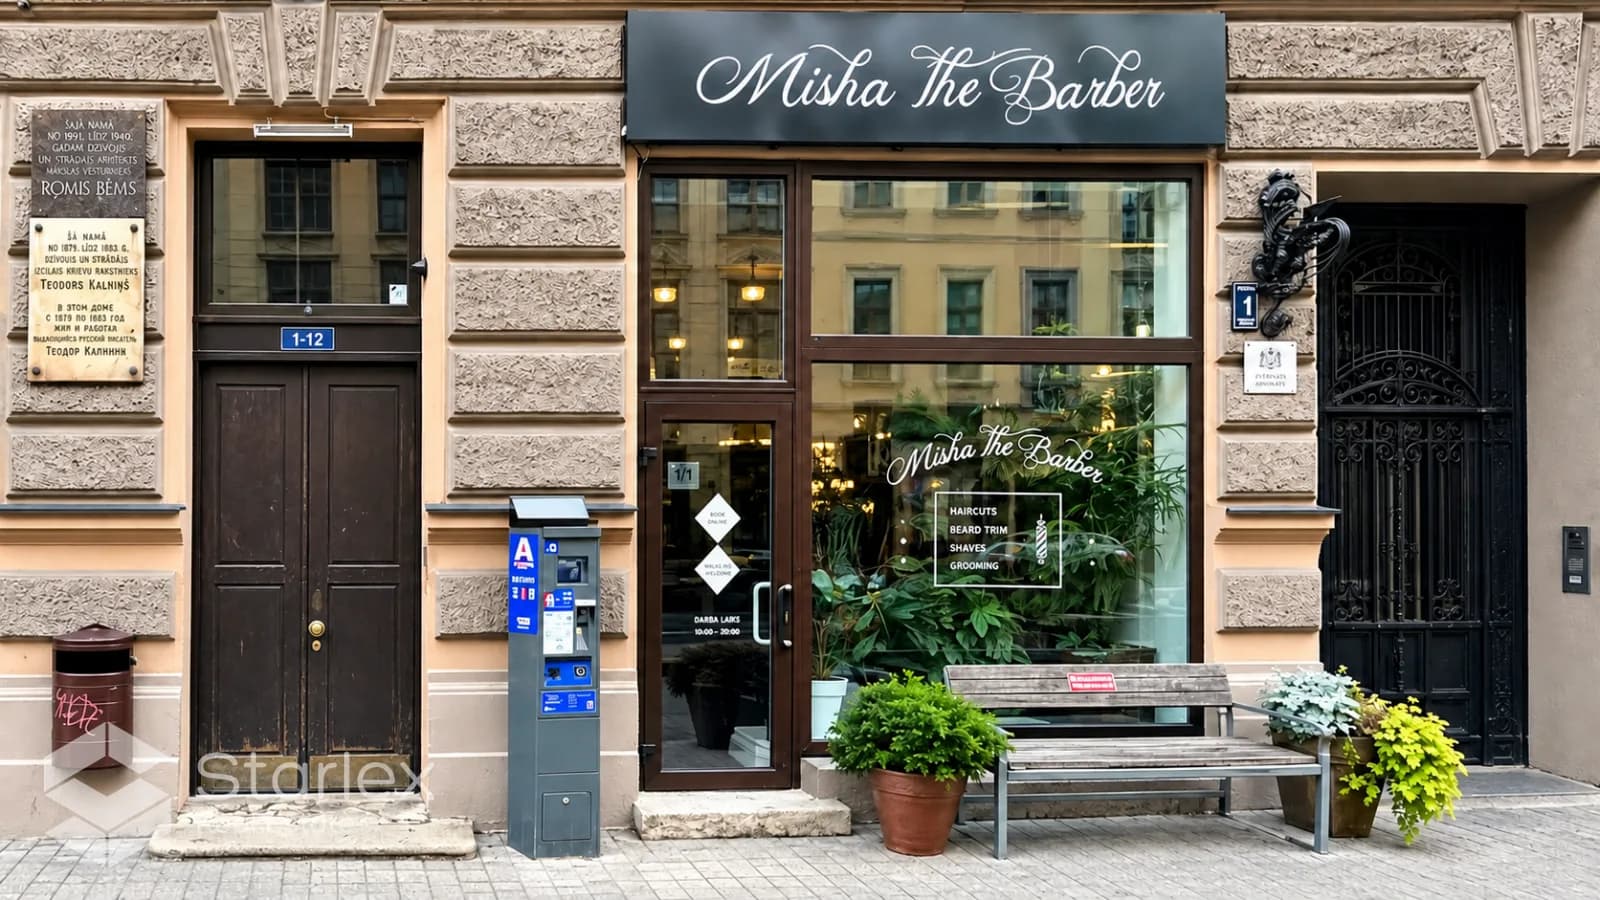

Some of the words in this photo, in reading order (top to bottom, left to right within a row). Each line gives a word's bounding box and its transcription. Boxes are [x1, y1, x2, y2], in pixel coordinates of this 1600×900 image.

[696, 44, 896, 109] Misha
[911, 46, 1031, 109] The
[990, 45, 1165, 125] Barber
[47, 131, 61, 141] NO
[111, 132, 133, 141] 1940.
[38, 154, 51, 164] UN
[48, 244, 59, 252] NO
[79, 255, 90, 263] UN
[40, 279, 84, 290] TEODORS
[1243, 295, 1252, 316] 1
[292, 333, 324, 346] 1-12
[886, 431, 977, 486] Misha
[979, 424, 1043, 457] The
[1018, 434, 1103, 484] Barber
[674, 468, 692, 481] 1/1
[950, 507, 997, 516] HAIRCUTS
[950, 525, 981, 535] BEARD
[984, 525, 1008, 535] TRIM
[514, 537, 534, 561] A
[950, 543, 986, 553] SHAVES
[950, 561, 999, 570] GROOMING
[720, 615, 740, 623] LAIKS
